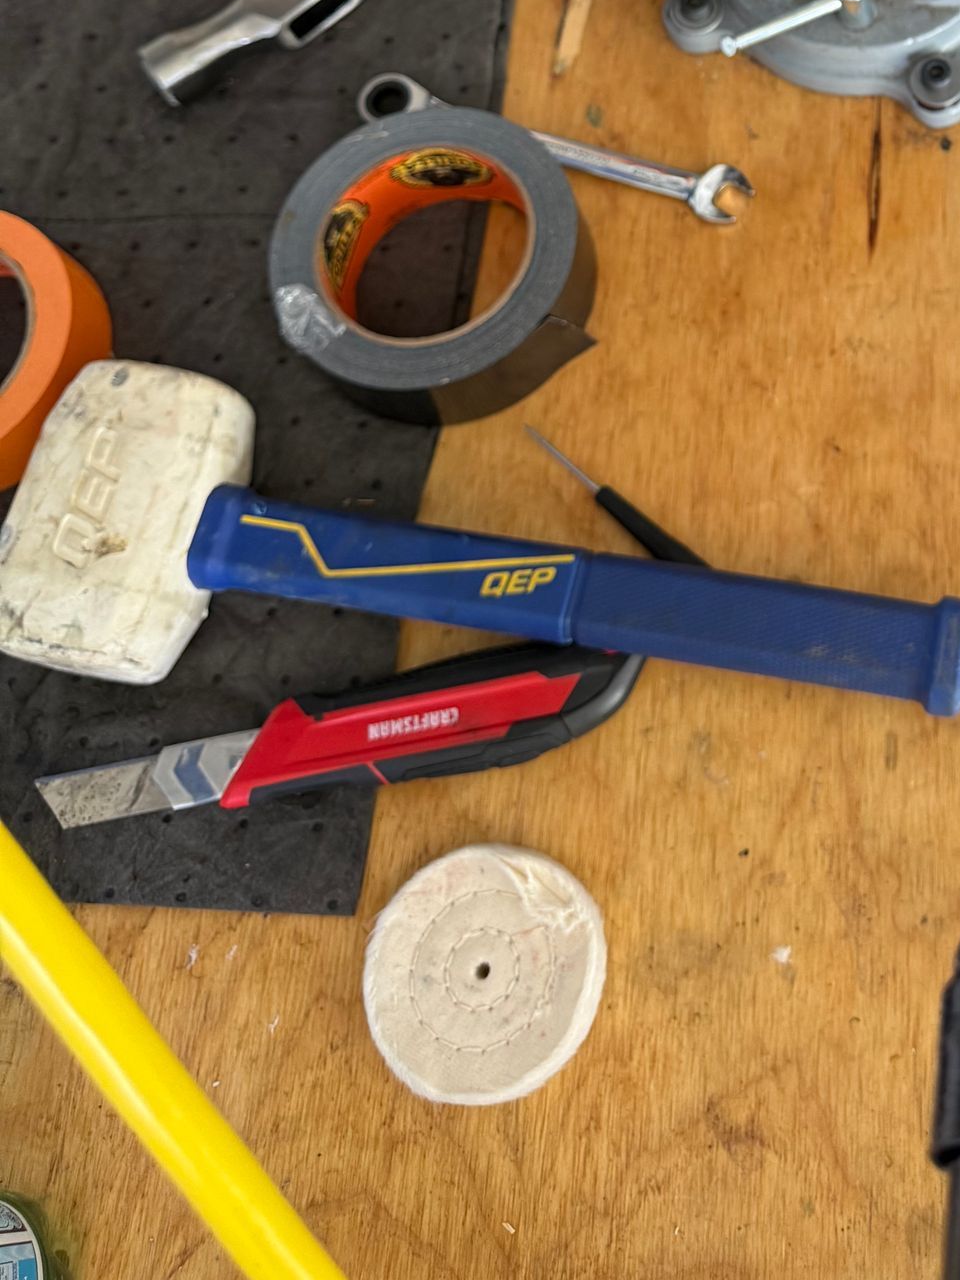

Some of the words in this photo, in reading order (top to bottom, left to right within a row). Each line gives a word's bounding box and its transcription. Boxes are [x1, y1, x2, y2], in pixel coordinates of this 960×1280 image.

[52, 426, 122, 570] QEP
[480, 566, 558, 597] QEP
[367, 706, 460, 741] CRAFTSMAN
